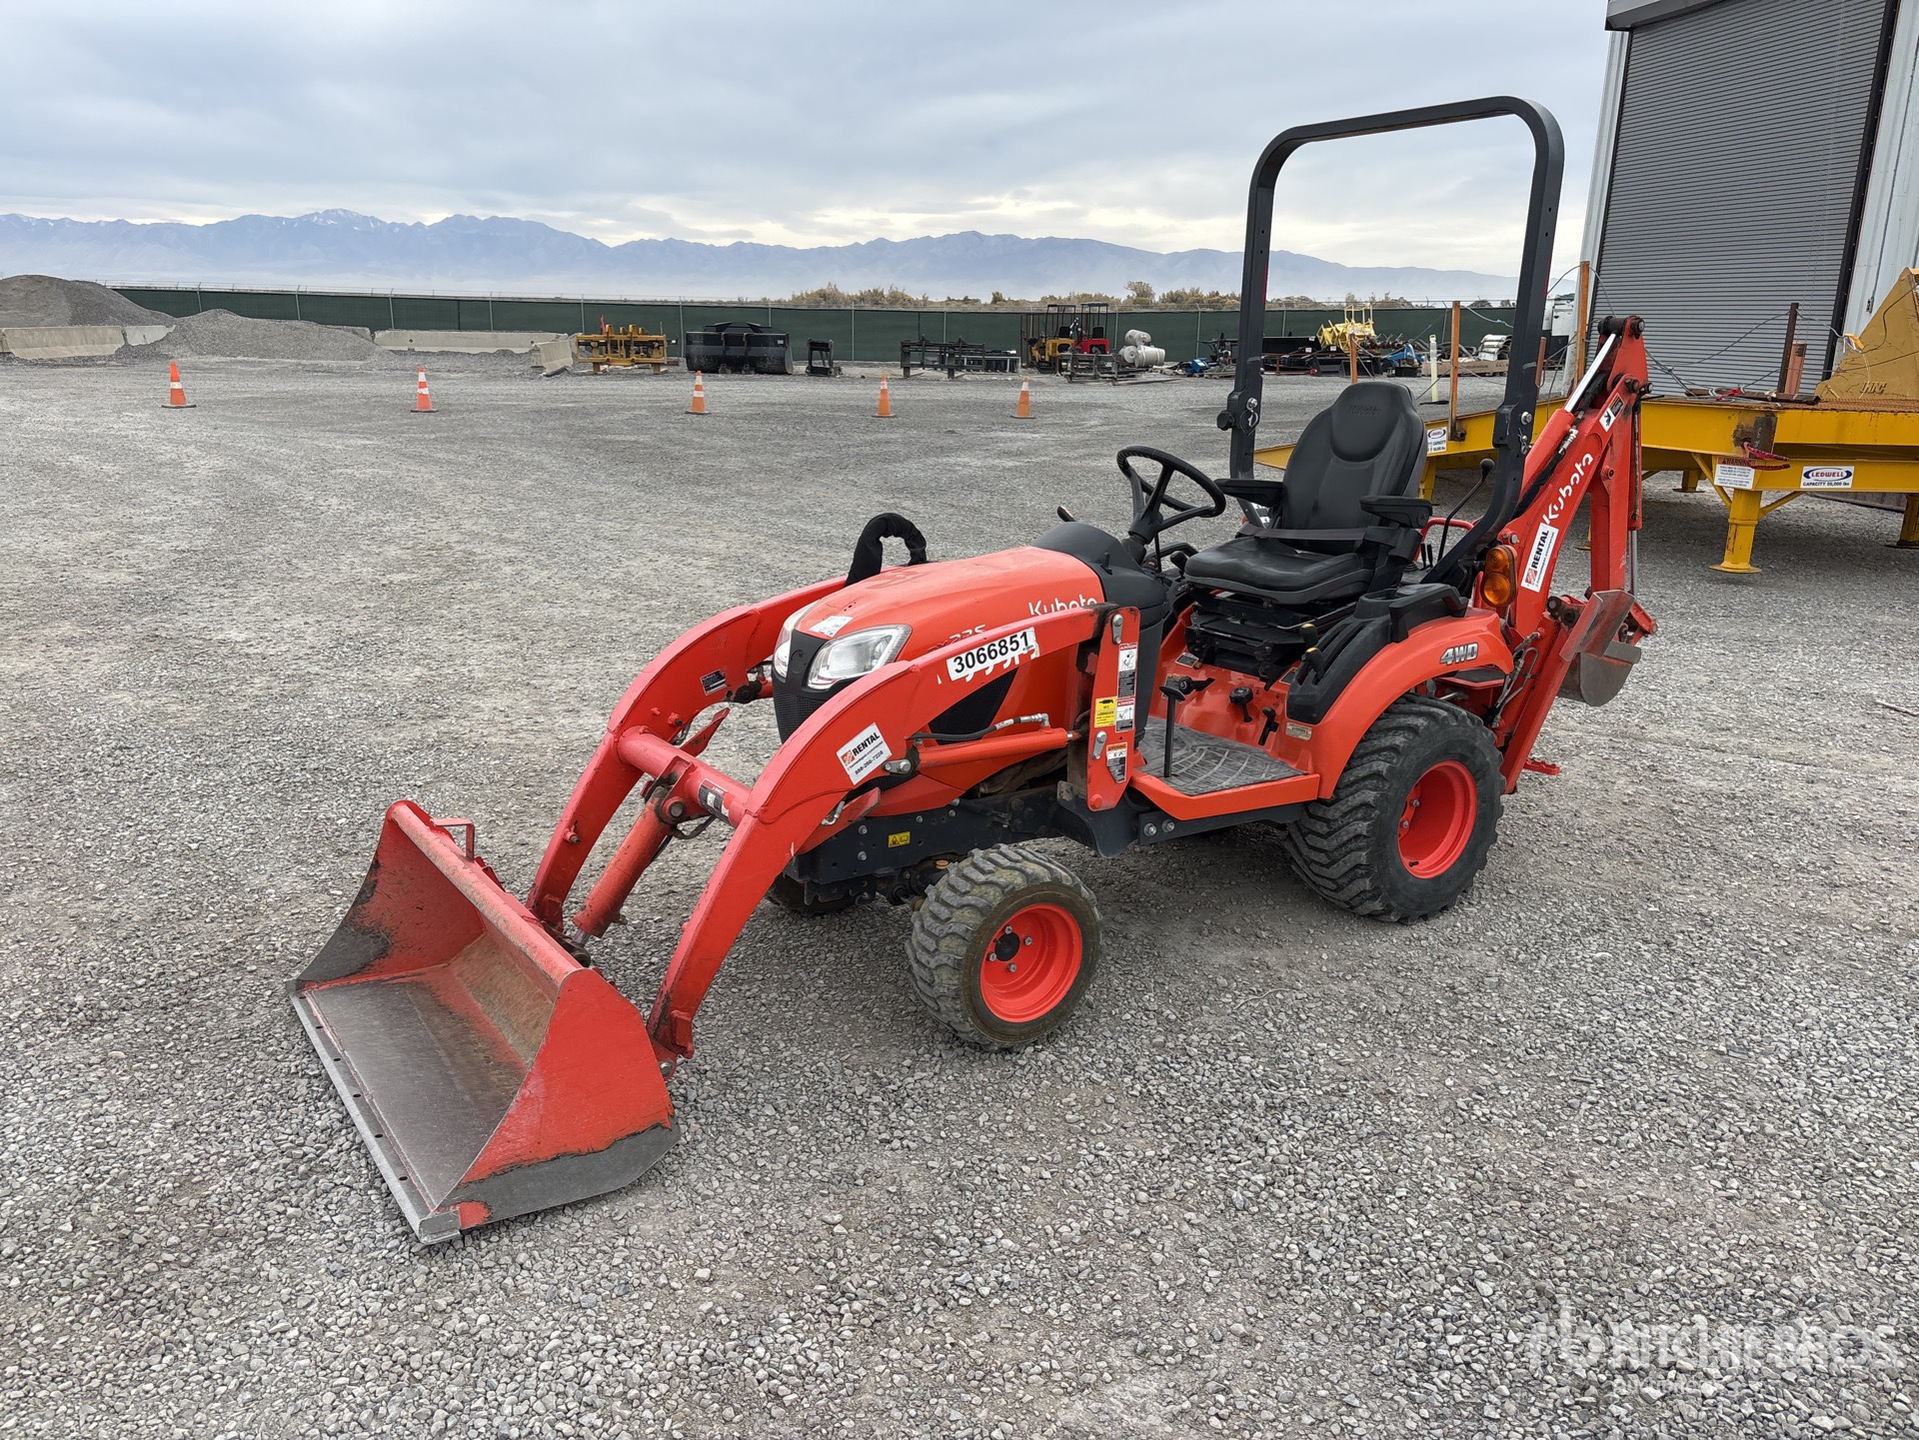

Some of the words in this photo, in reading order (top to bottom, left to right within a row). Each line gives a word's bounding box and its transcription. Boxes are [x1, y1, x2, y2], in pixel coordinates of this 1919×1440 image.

[1541, 452, 1594, 525] Kubota
[1530, 529, 1550, 569] RENTAL
[953, 631, 1029, 674] 3066851
[1440, 642, 1479, 665] 4WD
[852, 732, 880, 757] RENTAL
